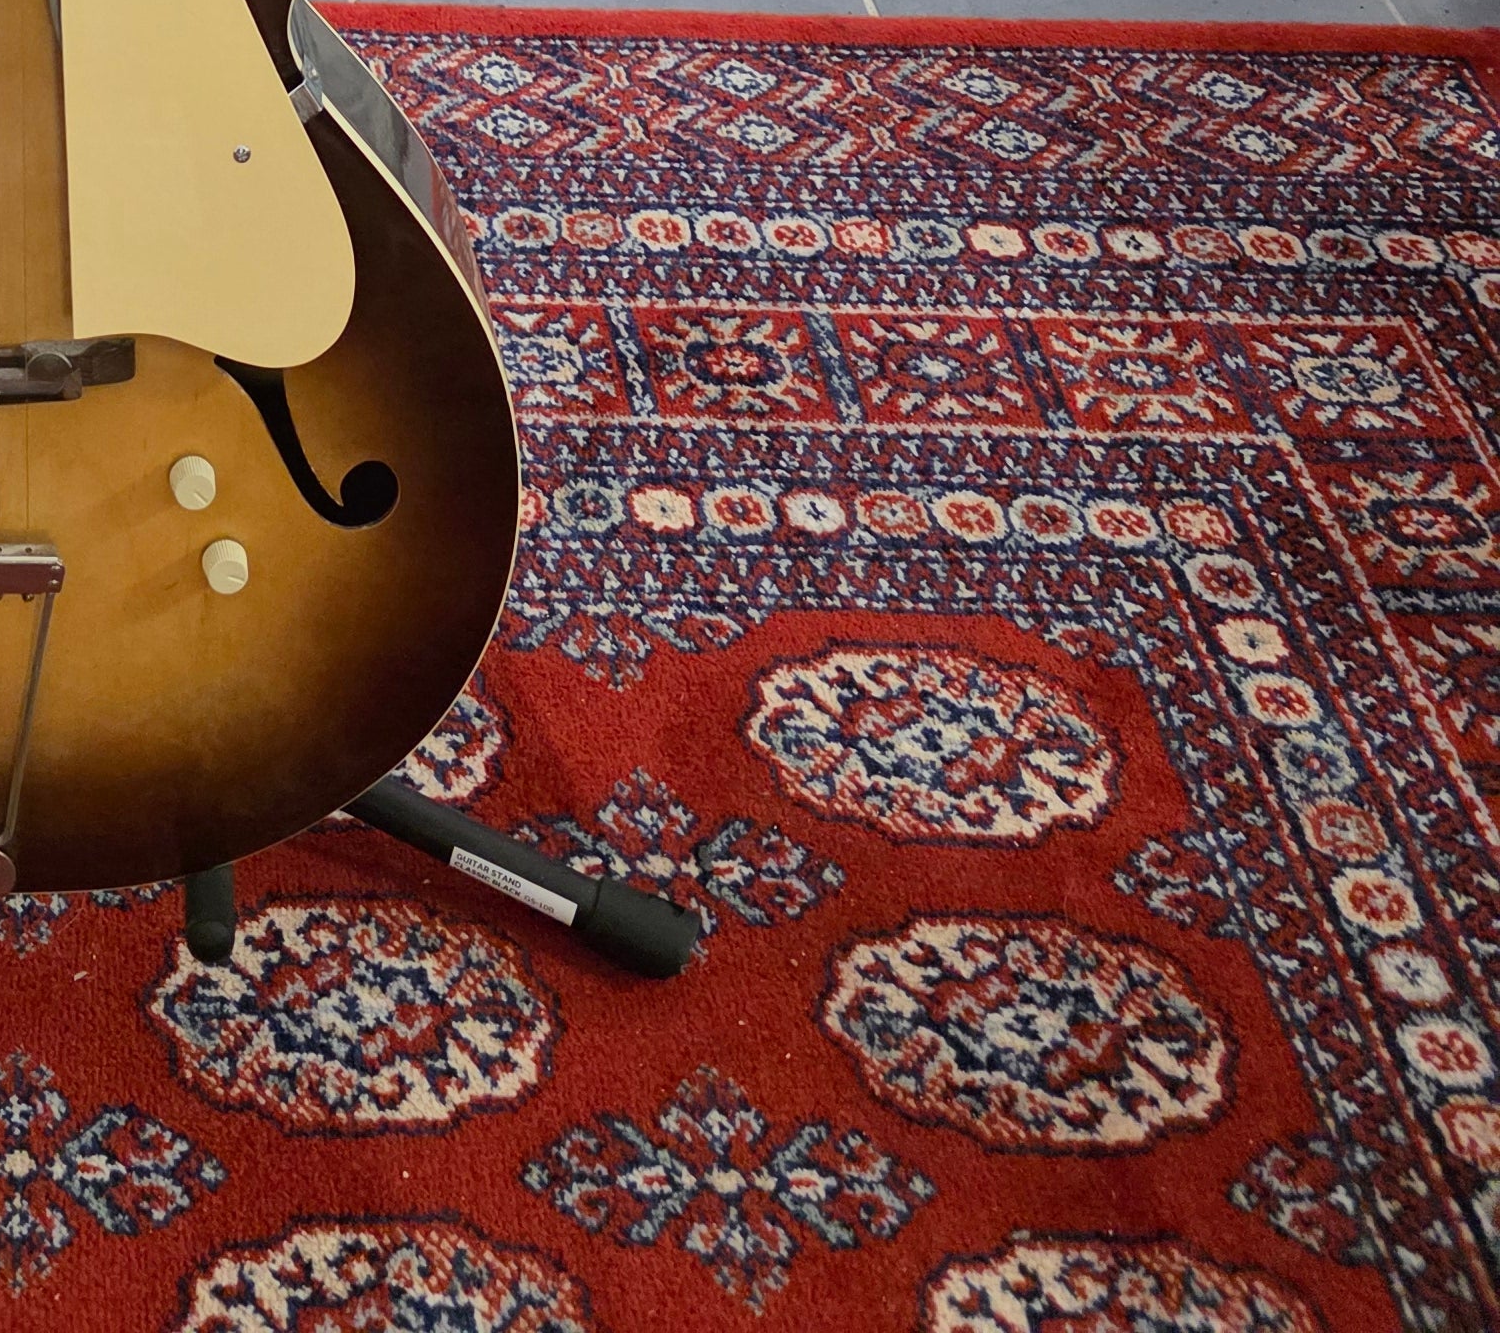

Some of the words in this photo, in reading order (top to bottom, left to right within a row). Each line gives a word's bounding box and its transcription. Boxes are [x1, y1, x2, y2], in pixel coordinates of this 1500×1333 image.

[453, 861, 491, 883] CLASSIC
[491, 879, 522, 897] BLACK
[456, 853, 490, 874] GUITAR
[490, 869, 522, 889] STAND
